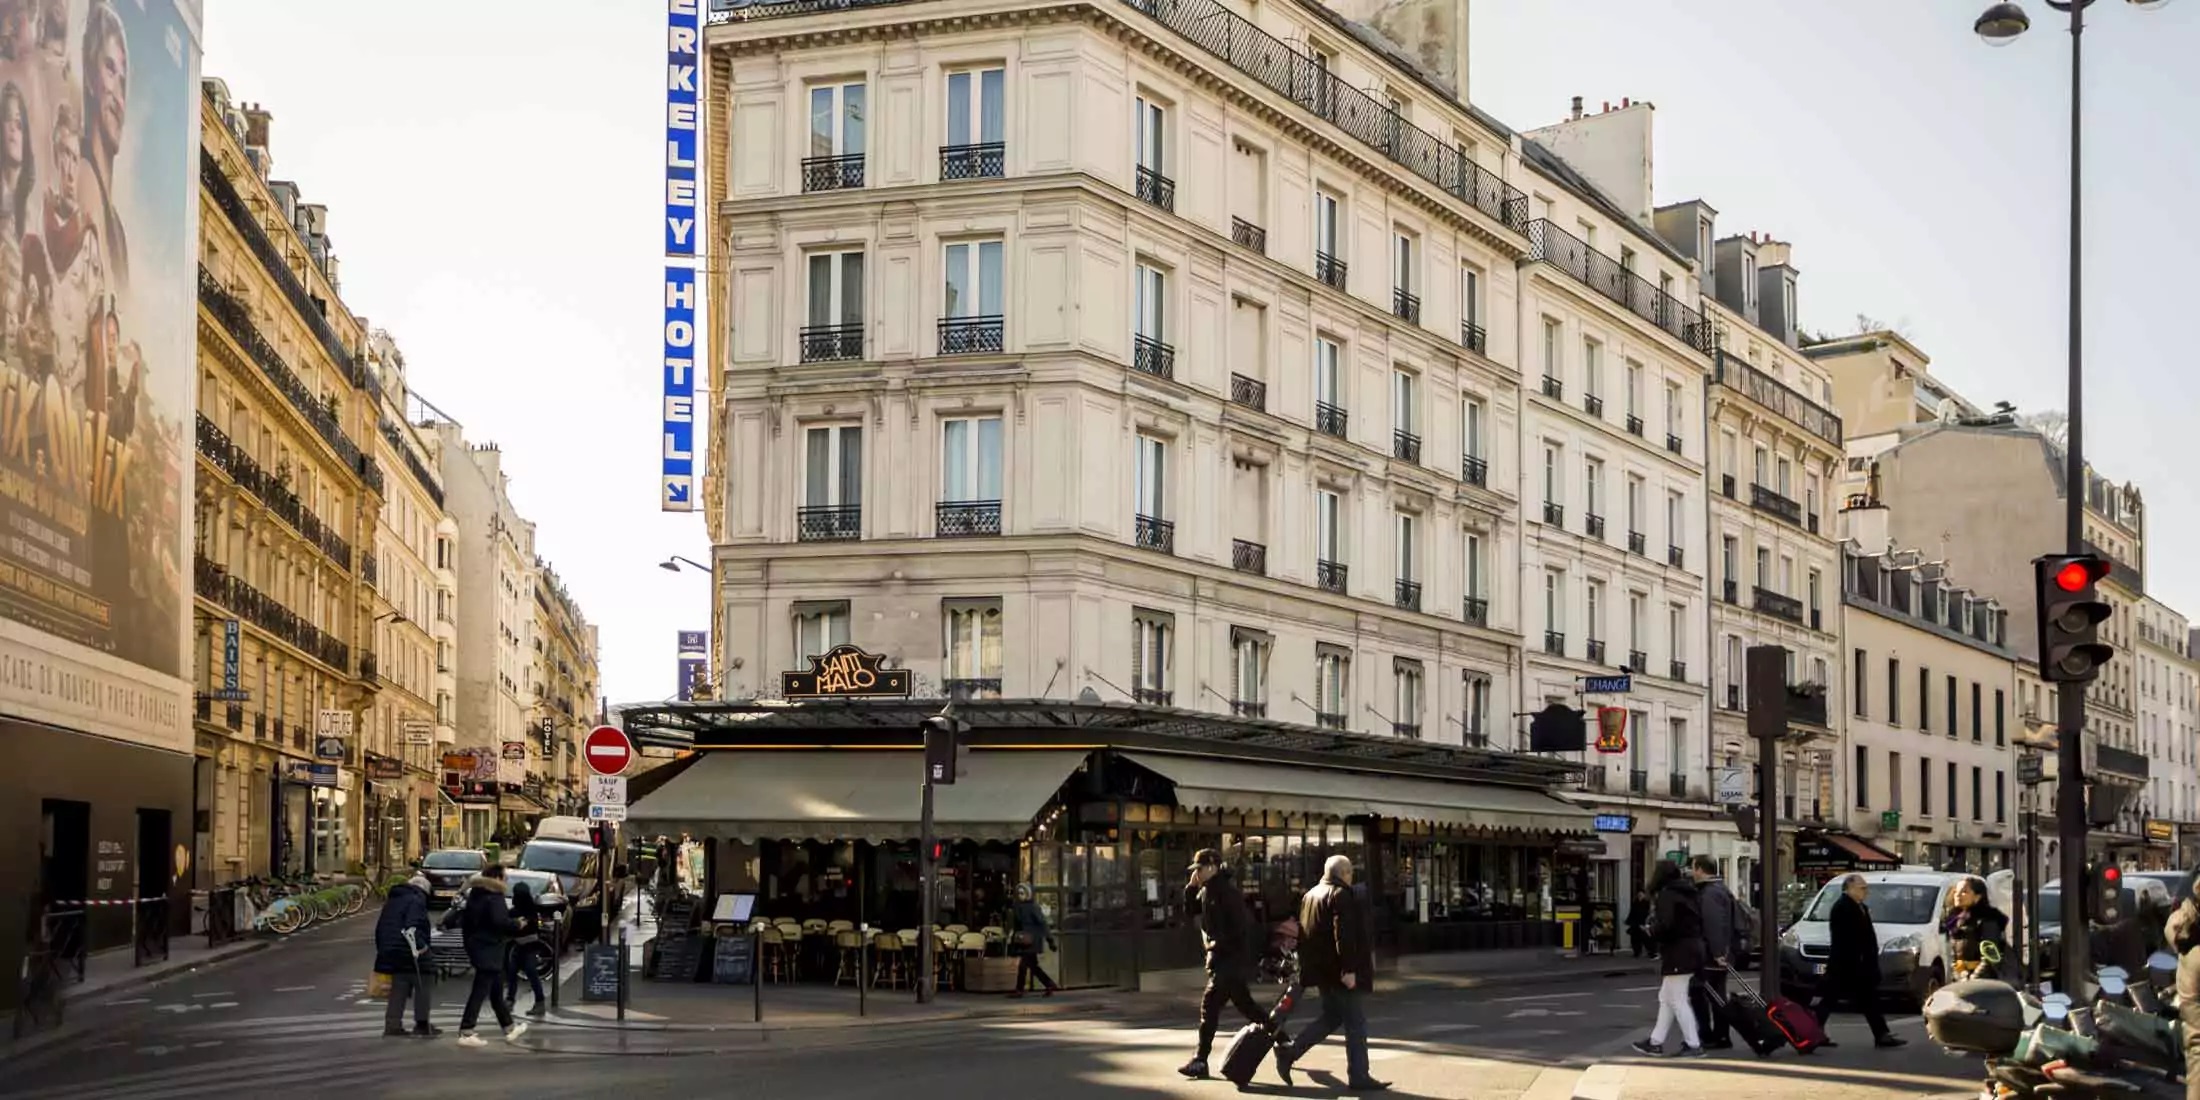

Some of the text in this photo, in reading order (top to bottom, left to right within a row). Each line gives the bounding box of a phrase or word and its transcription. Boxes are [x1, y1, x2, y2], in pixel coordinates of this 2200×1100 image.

[664, 281, 694, 461] HOTEL
[226, 621, 238, 688] BAINS
[816, 667, 876, 694] MALO
[1586, 678, 1628, 692] CHANGE
[543, 718, 553, 754] HOTEL
[598, 777, 618, 785] SAUF
[1594, 815, 1630, 830] CHANGE
